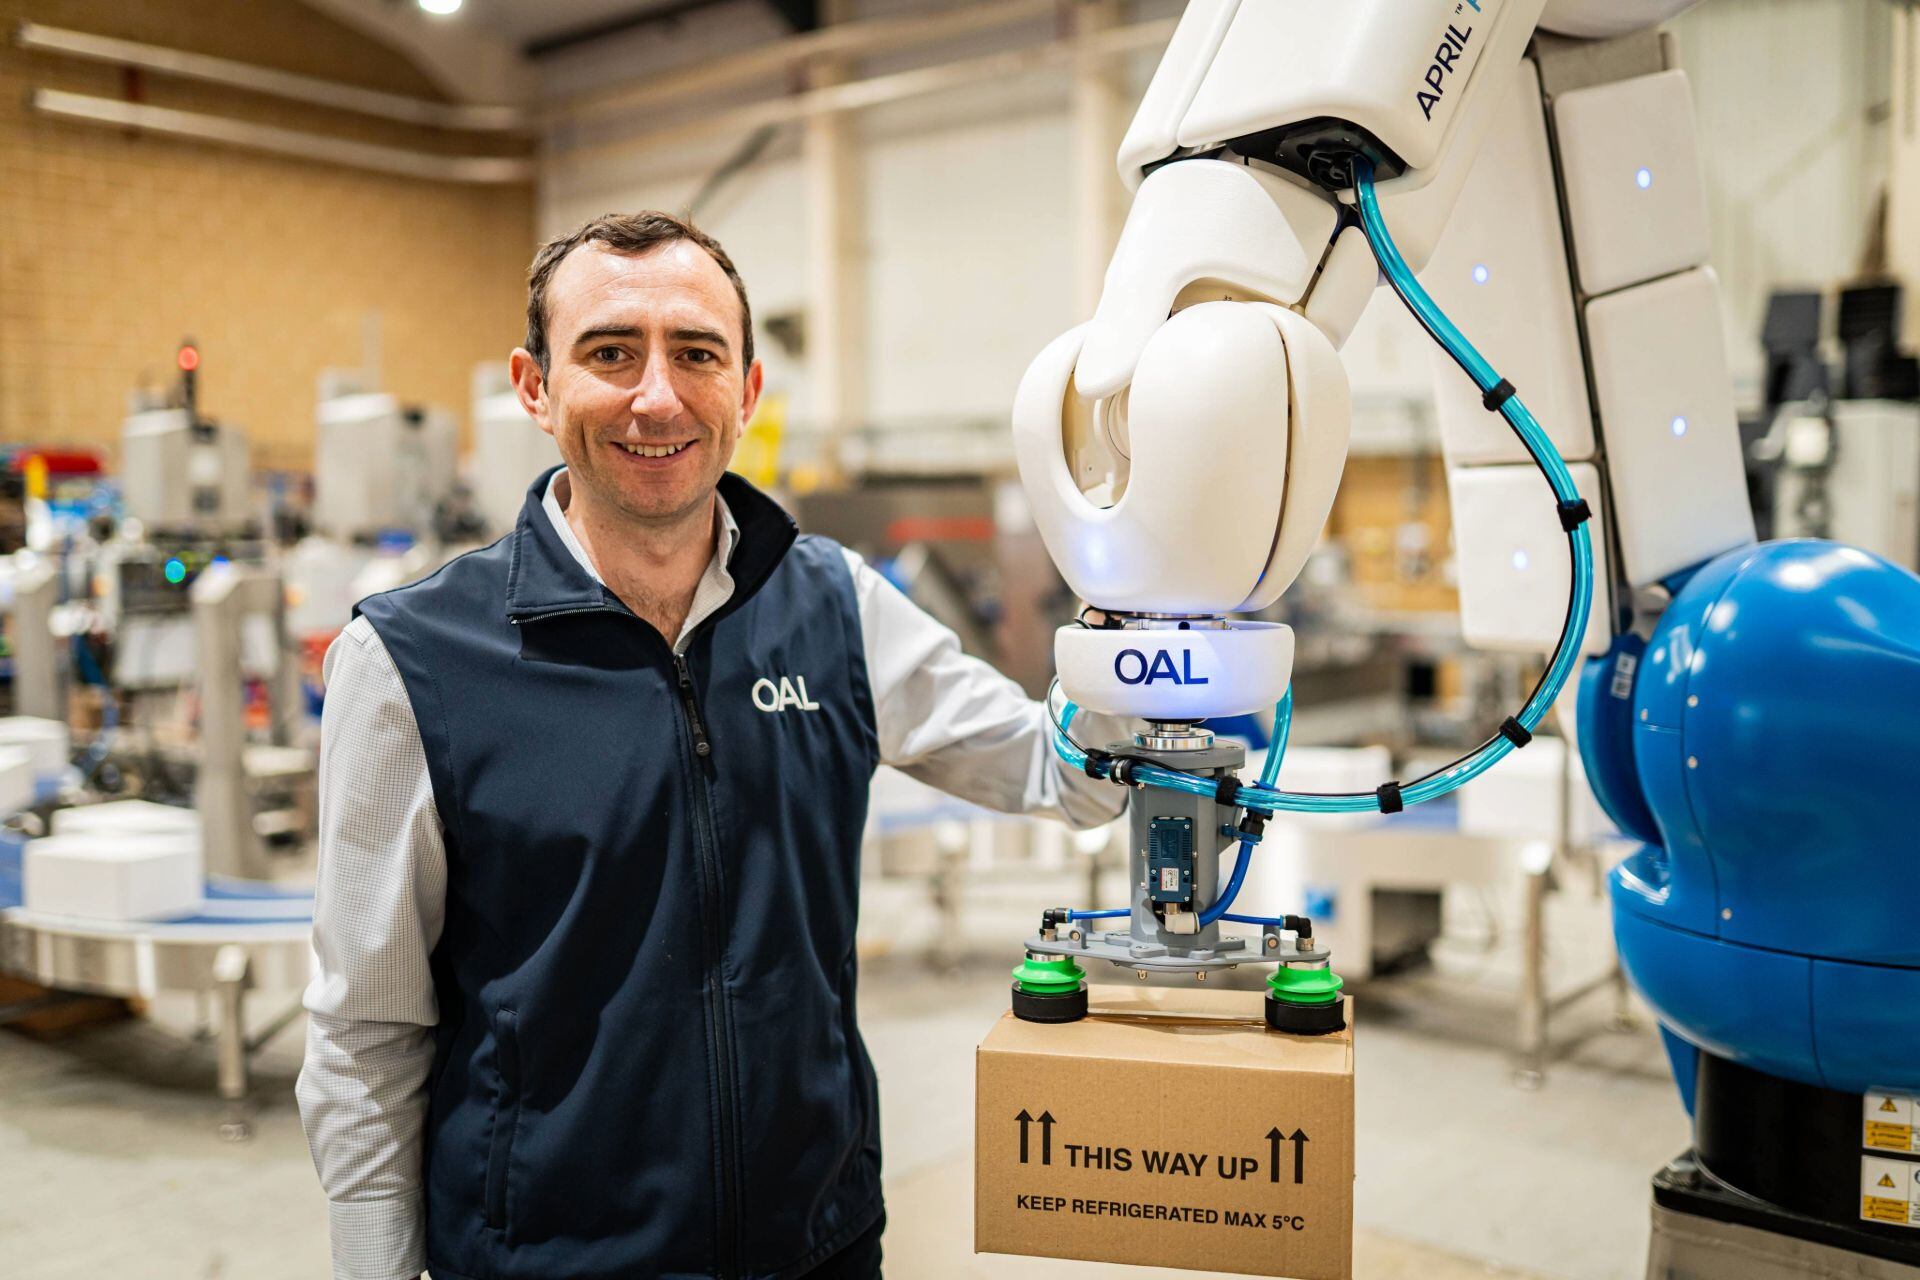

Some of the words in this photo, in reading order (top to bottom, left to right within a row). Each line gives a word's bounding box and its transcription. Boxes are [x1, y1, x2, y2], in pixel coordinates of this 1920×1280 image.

[1114, 648, 1209, 685] OAL
[751, 675, 820, 713] OAL
[1064, 1144, 1133, 1172] THIS
[1141, 1149, 1209, 1177] WAY
[1217, 1155, 1259, 1181] UP
[1017, 1194, 1067, 1212] KEEP
[1072, 1198, 1219, 1225] REFRIGERATED
[1224, 1210, 1267, 1229] MAX
[1271, 1214, 1305, 1232] 5°C
